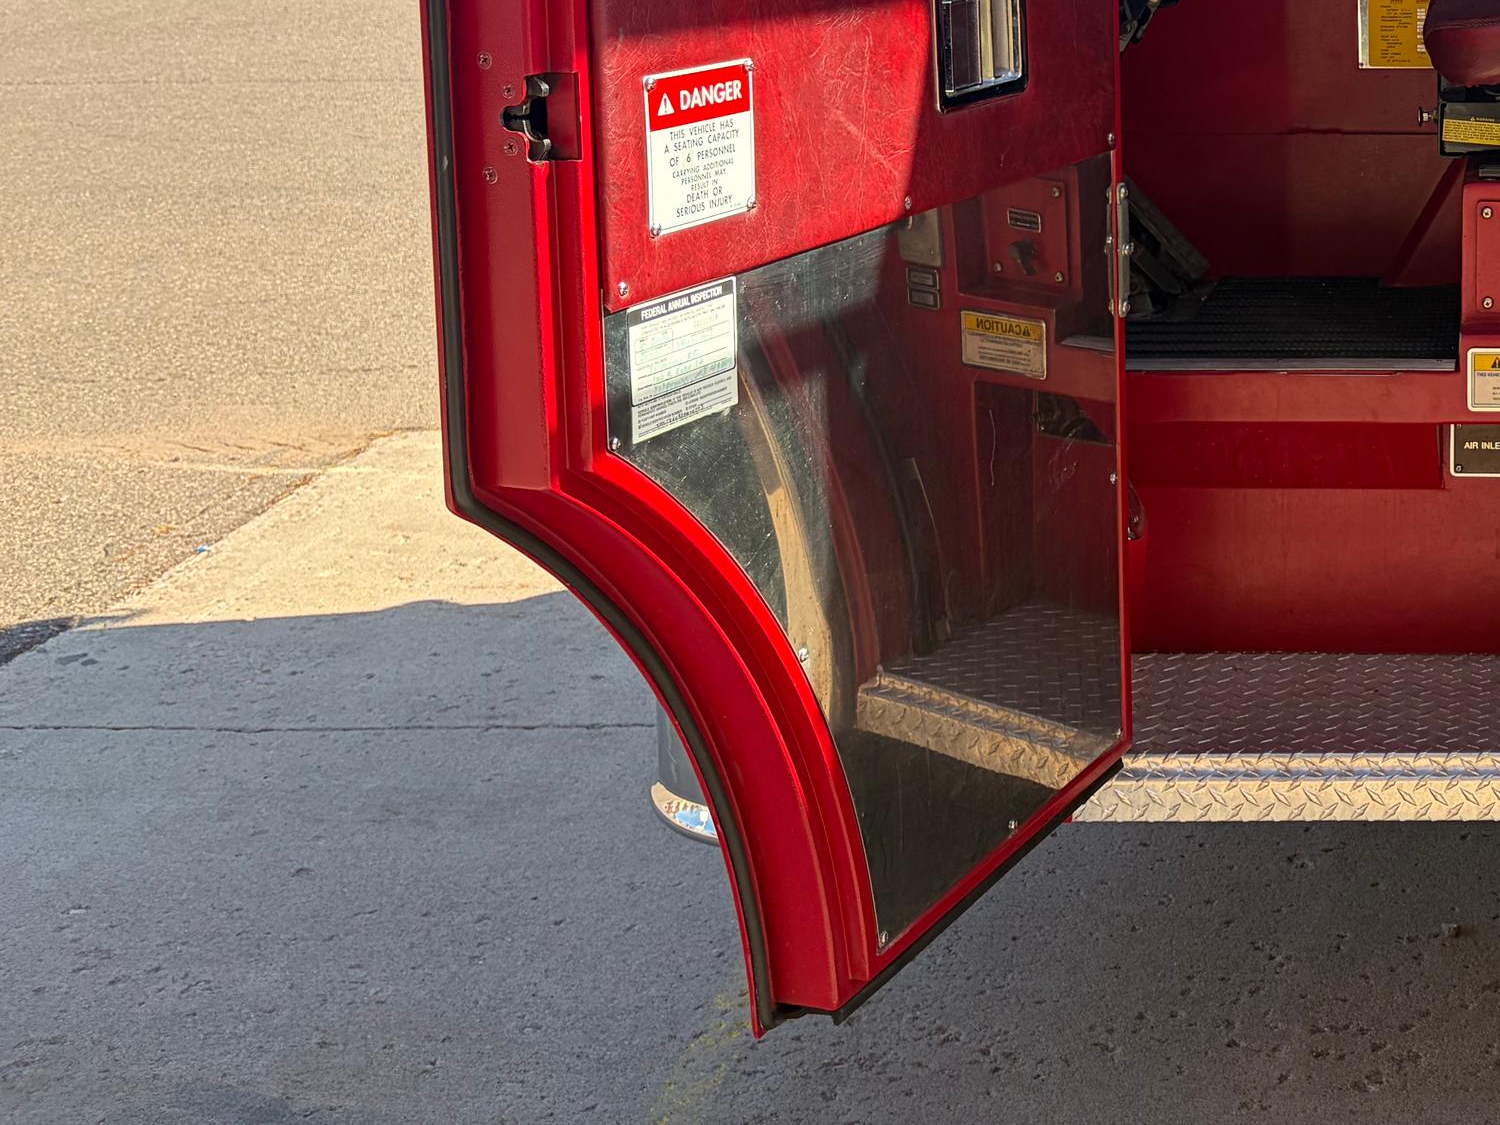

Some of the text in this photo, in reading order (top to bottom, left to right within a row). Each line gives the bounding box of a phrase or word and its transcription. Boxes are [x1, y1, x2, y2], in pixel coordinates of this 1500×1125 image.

[679, 79, 742, 111] DANGER
[670, 118, 734, 140] THIS VEHICLE HAS
[664, 128, 740, 154] A SEATING CAPACITY
[669, 143, 736, 167] OF 6 PERSONNEL
[672, 157, 734, 179] CARRYING ADDITIONAL
[681, 168, 726, 185] PERSONNEL MAY
[686, 186, 723, 204] DEATH OR
[691, 179, 718, 191] RESULT IN
[676, 202, 705, 218] SERIOUS
[709, 194, 733, 209] INJURY
[641, 303, 668, 321] FEDERAL
[668, 296, 690, 313] ANNUAL
[690, 285, 723, 305] INSPECTION
[1463, 441, 1479, 450] AIR
